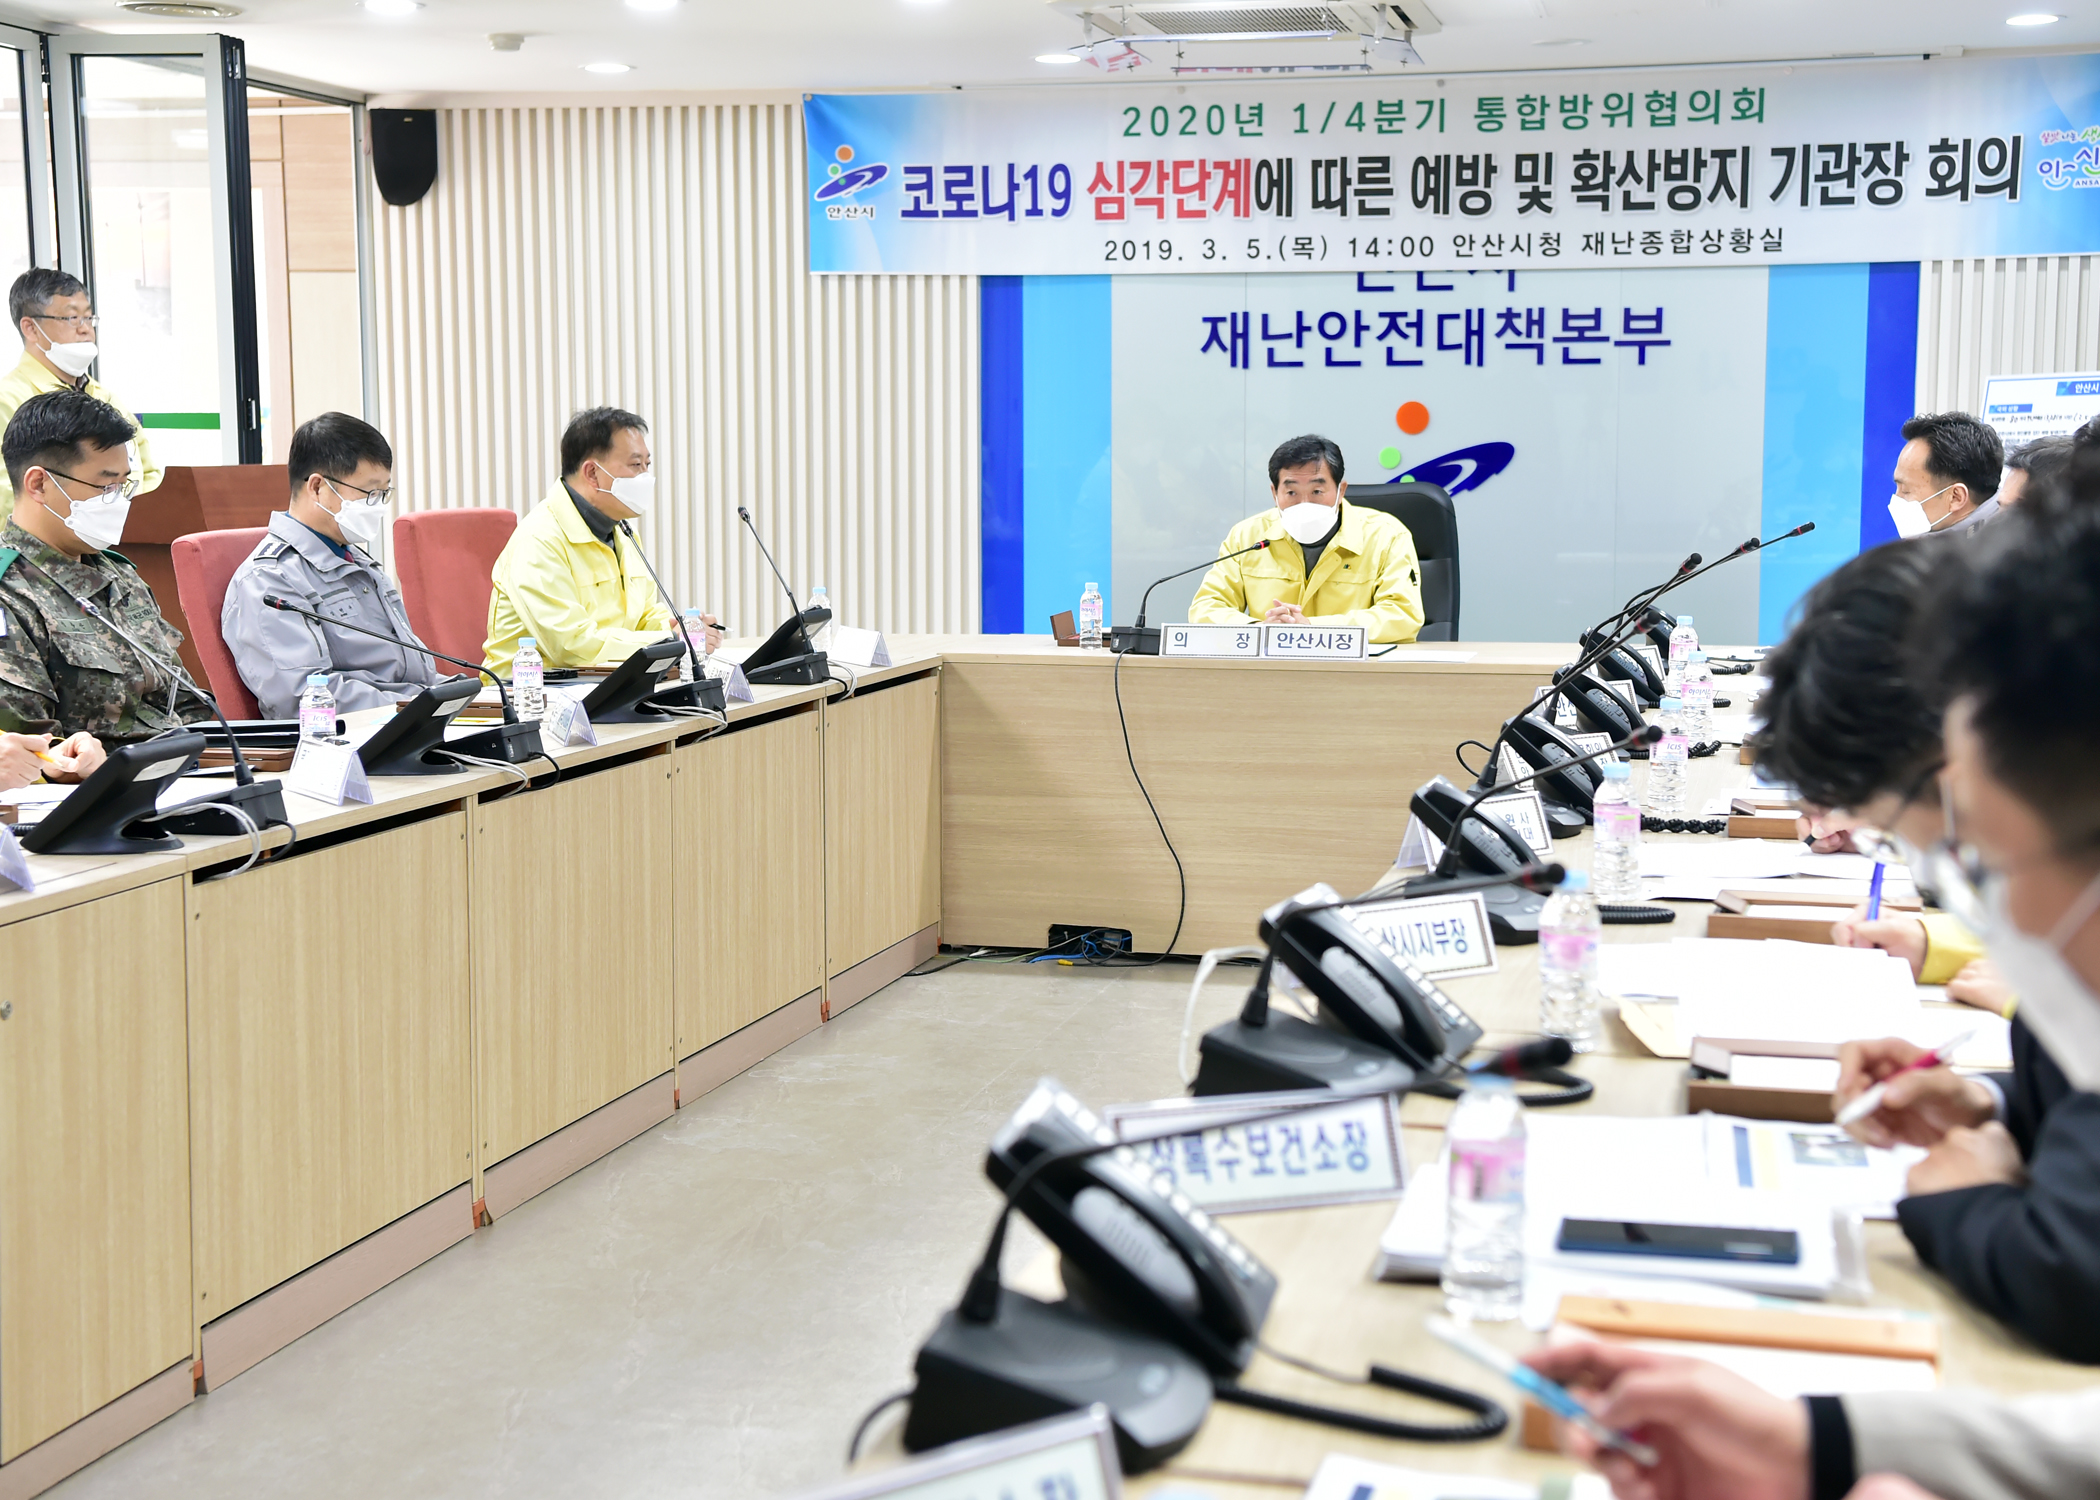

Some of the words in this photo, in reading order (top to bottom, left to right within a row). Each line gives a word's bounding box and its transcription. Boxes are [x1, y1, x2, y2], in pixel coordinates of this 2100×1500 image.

[1122, 102, 1264, 137] 2020년
[1292, 97, 1446, 134] 1/4분기
[1473, 86, 1766, 133] 통합방위협의회
[900, 161, 1072, 222] 코로나19
[1086, 155, 1293, 221] 심각단계에
[1310, 154, 1394, 217] 따른
[1411, 152, 1498, 216] 예방
[1513, 151, 1554, 215] 및
[1569, 144, 1751, 212] 확산방지
[1768, 139, 1911, 208] 기관장
[1924, 134, 2022, 202] 회의
[827, 207, 874, 219] 안산시
[1103, 239, 1184, 261] 2019.
[1201, 238, 1228, 261] 3.
[1246, 235, 1328, 261] 5.(목)
[1347, 235, 1435, 258] 14:00
[1451, 232, 1562, 259] 안산시청
[1580, 227, 1784, 256] 재난종합상황실
[1200, 305, 1672, 370] 재난안전대책본부
[1174, 631, 1189, 649] 의
[1236, 631, 1251, 650] 장
[1276, 631, 1354, 651] 안산시장
